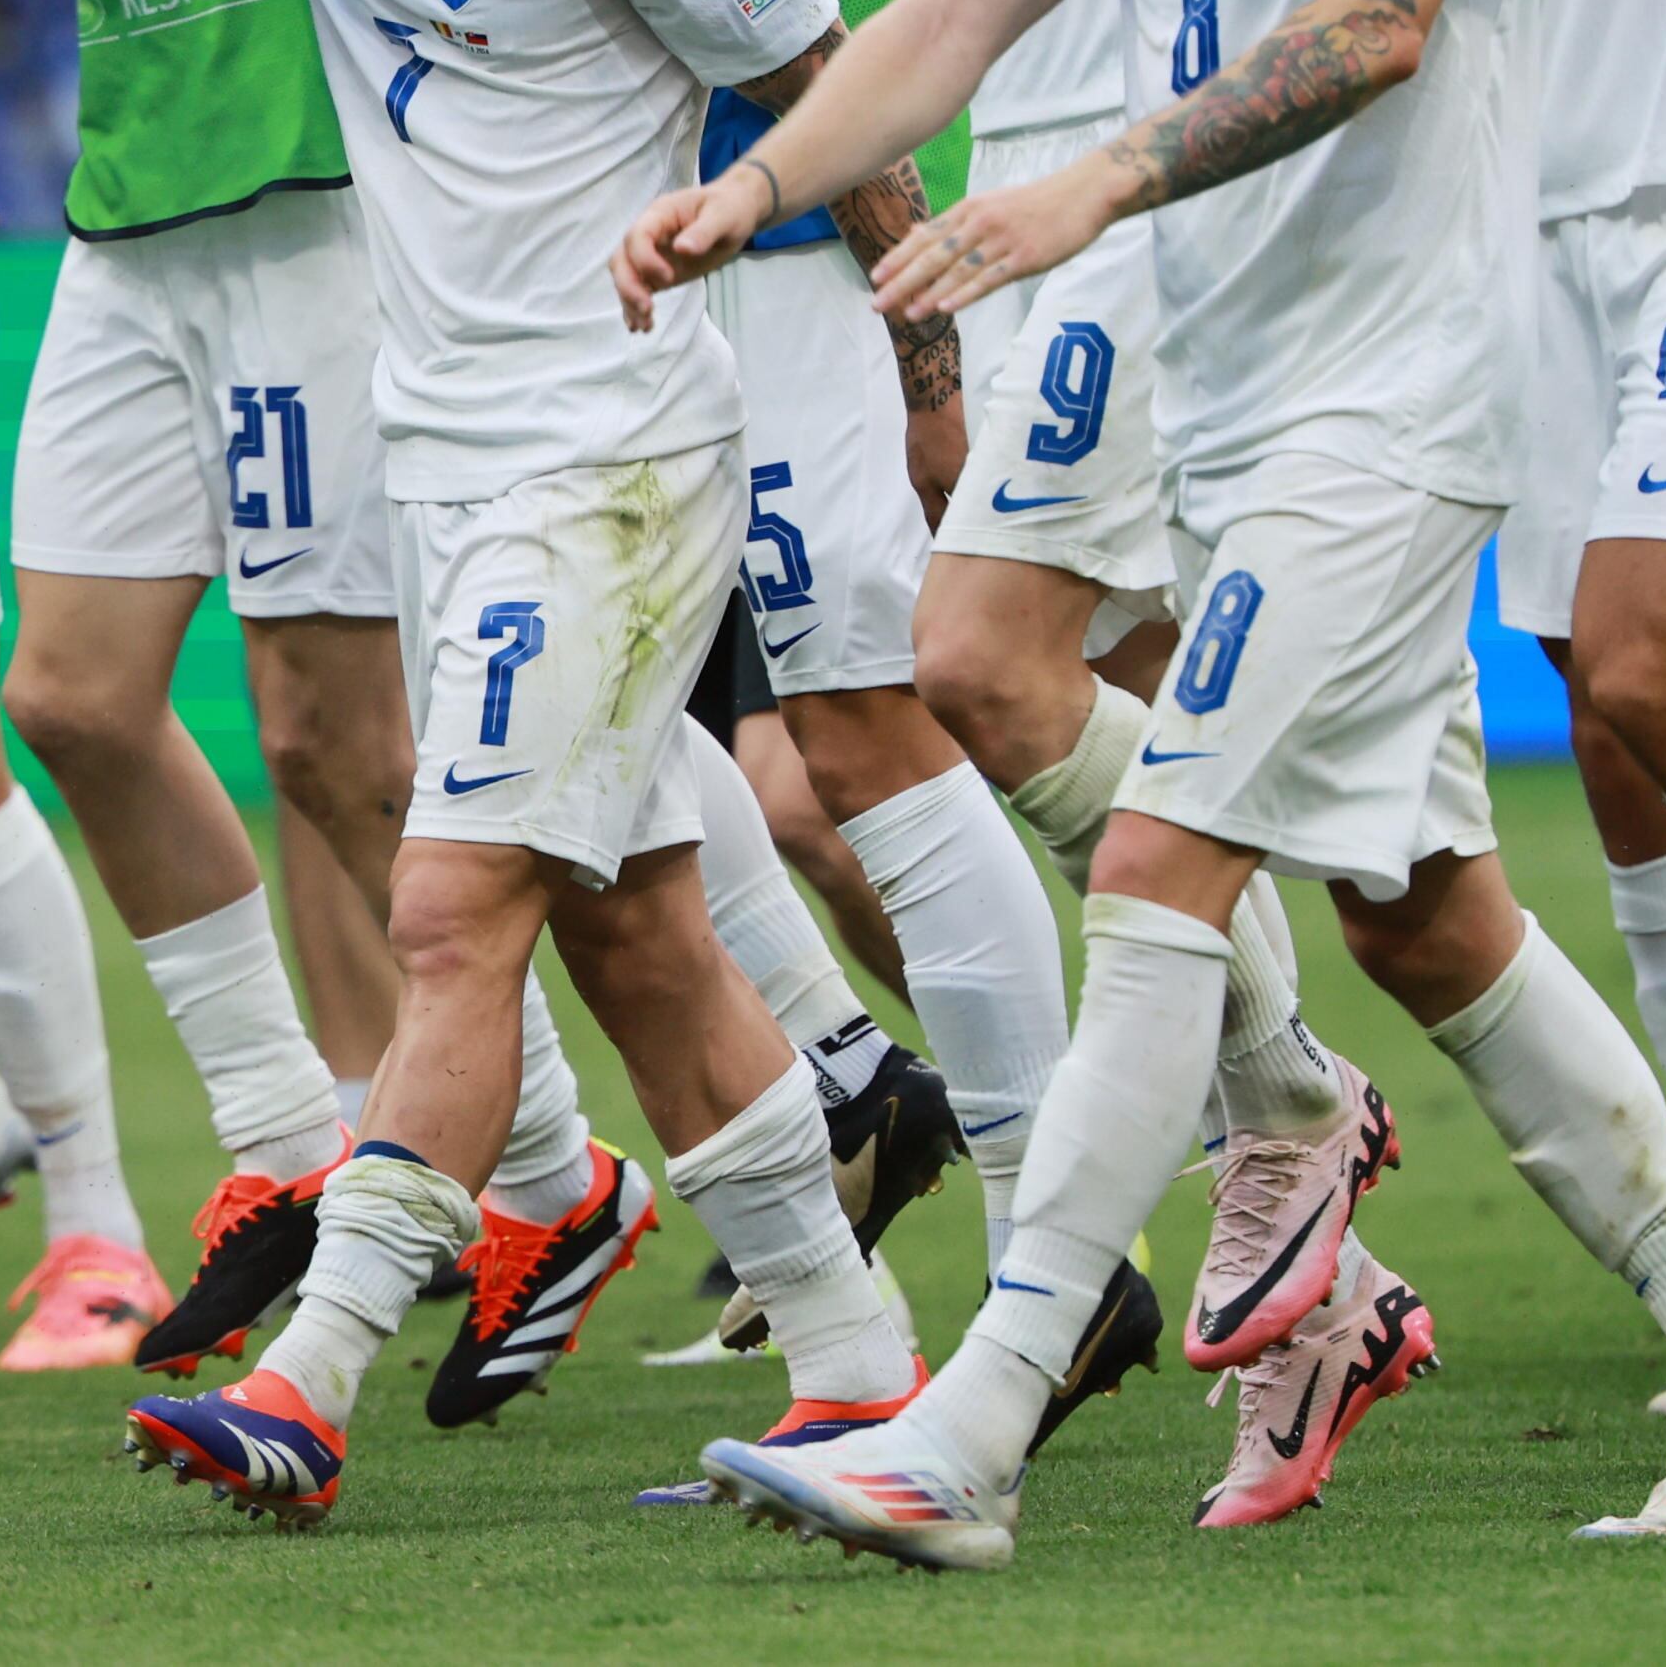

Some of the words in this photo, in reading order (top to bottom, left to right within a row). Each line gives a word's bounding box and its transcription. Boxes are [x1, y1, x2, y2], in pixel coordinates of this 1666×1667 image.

[227, 385, 313, 529] 21
[1025, 321, 1116, 467] 9
[737, 460, 818, 614] 5
[477, 601, 546, 747] 7
[1174, 569, 1264, 716] 8
